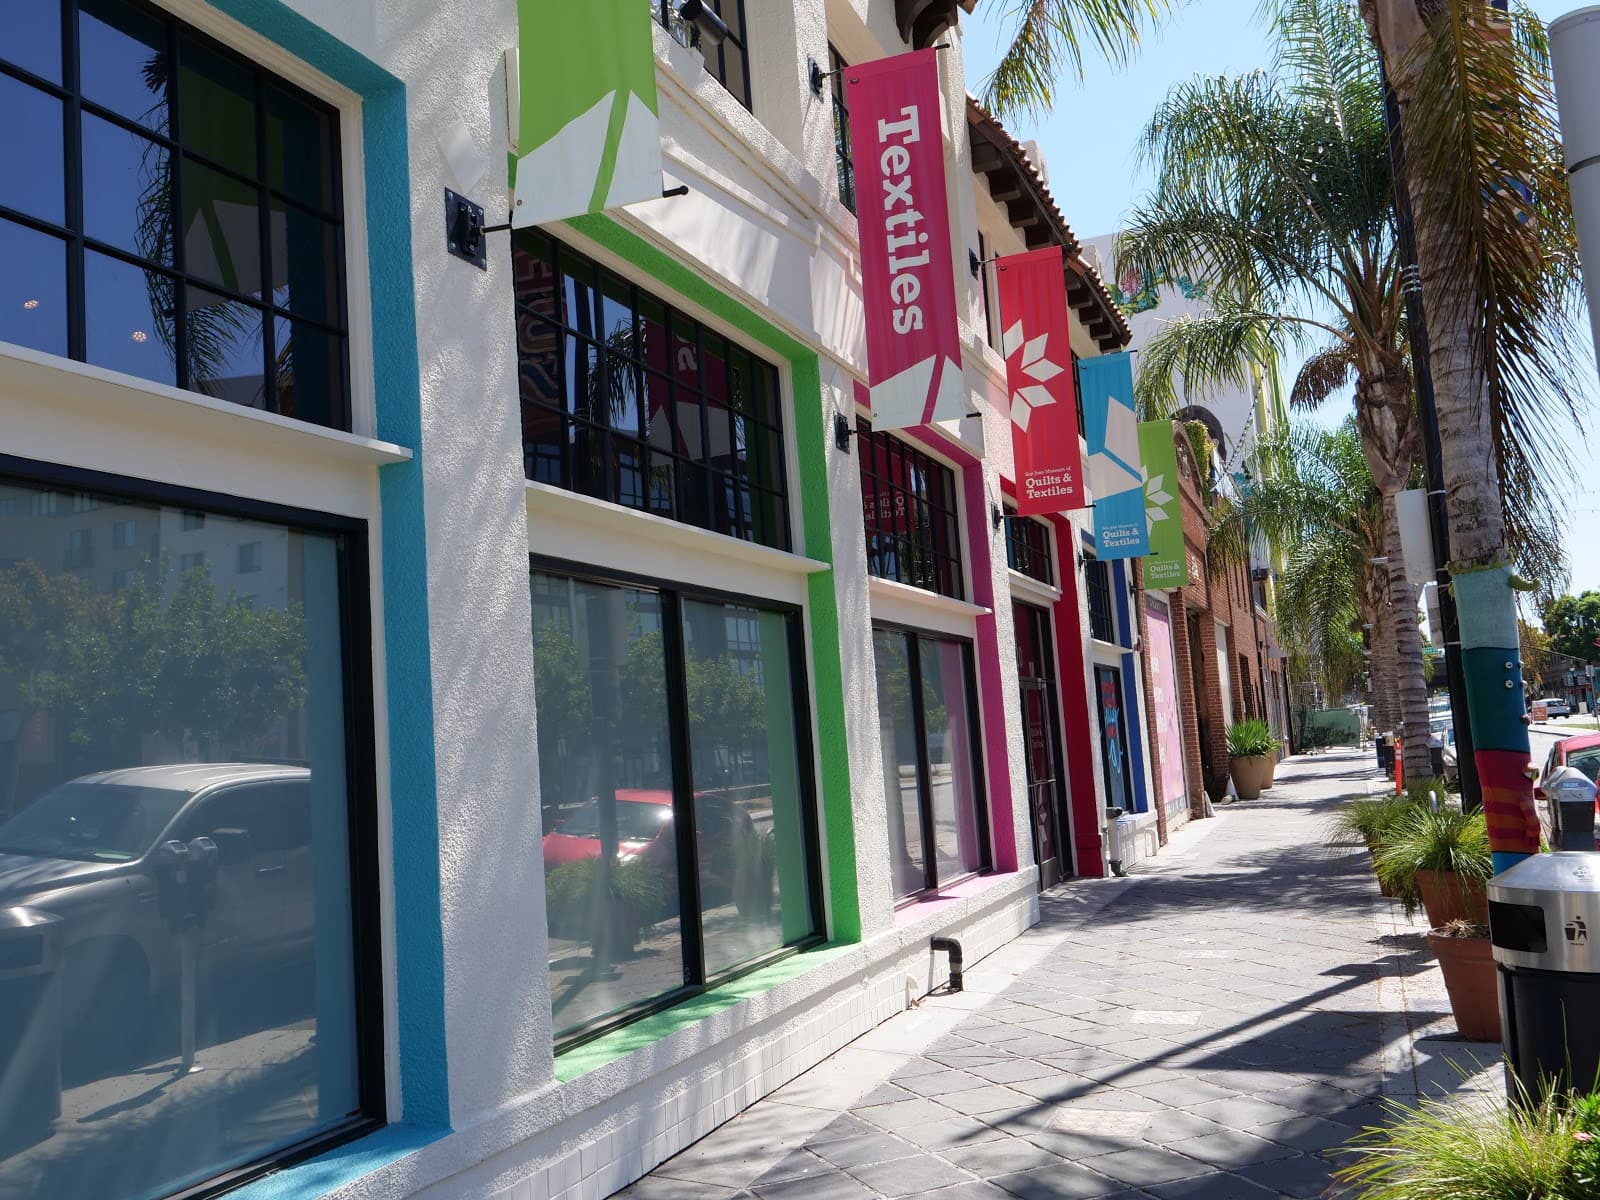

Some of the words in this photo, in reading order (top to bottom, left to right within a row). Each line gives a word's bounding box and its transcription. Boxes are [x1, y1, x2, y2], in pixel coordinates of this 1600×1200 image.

[877, 104, 930, 335] Textiles
[1025, 475, 1061, 489] Quilts
[1063, 473, 1073, 482] &
[1026, 486, 1073, 499] Textiles
[1103, 529, 1130, 539] Quilts
[1103, 537, 1140, 547] Textiles
